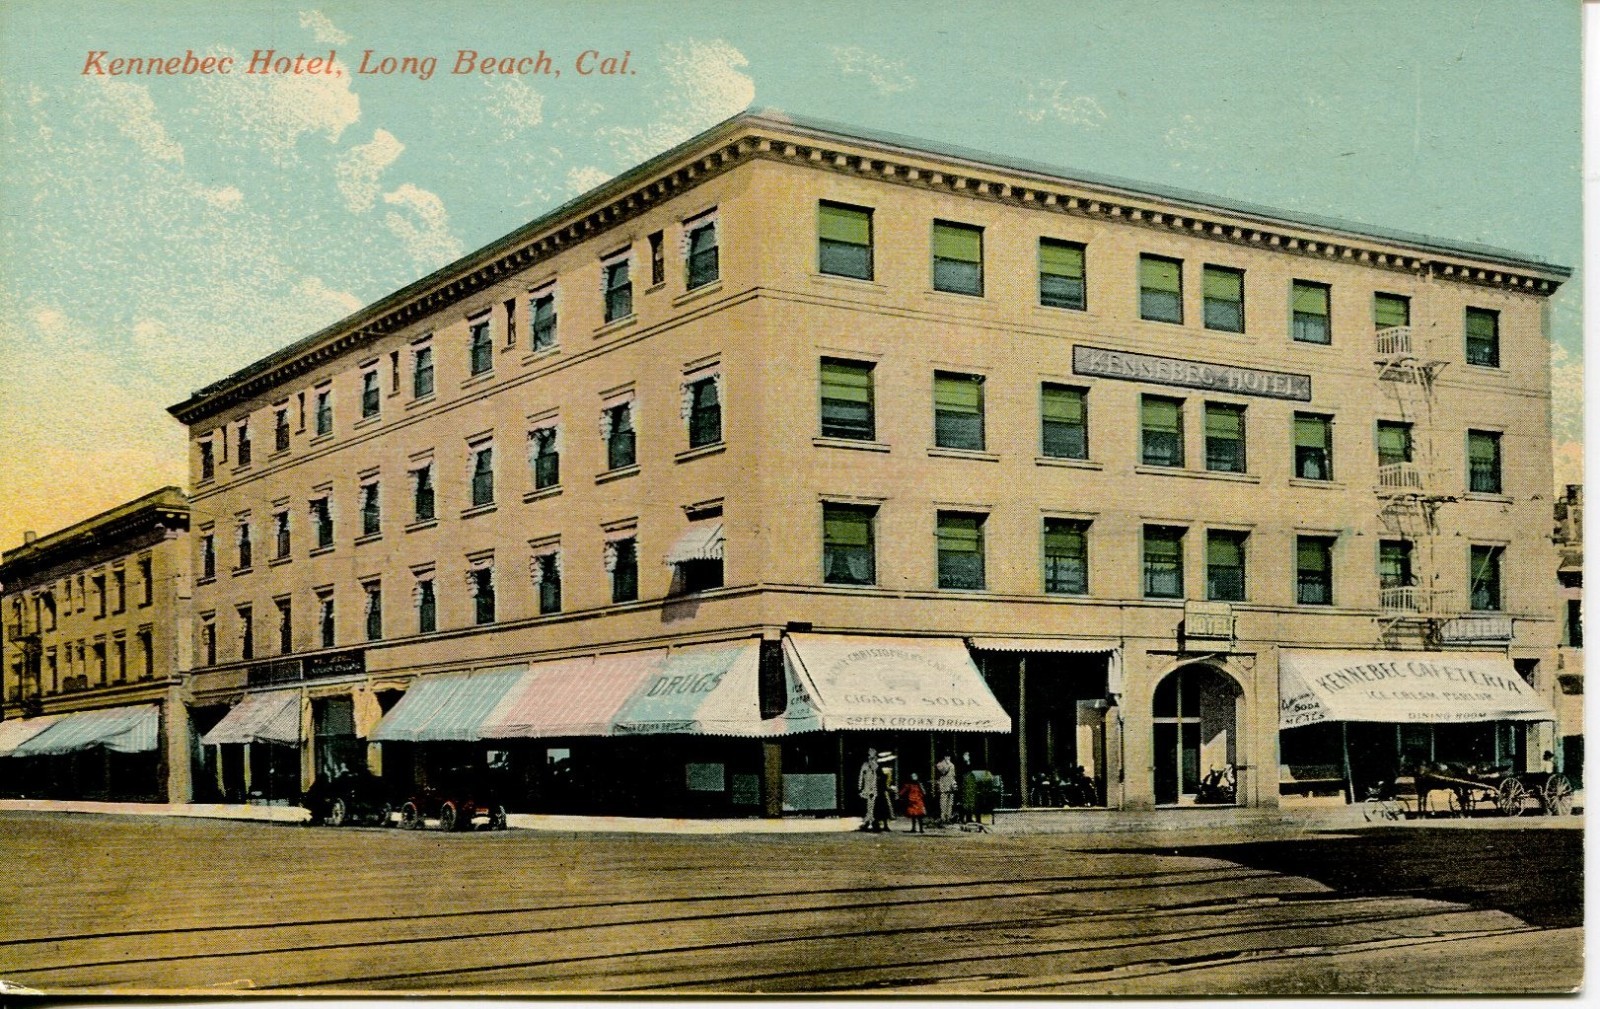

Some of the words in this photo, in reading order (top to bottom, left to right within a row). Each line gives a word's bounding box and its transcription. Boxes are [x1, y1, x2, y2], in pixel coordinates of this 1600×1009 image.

[1089, 353, 1216, 386] KENNEBEC
[1227, 370, 1297, 396] HOTEL
[1186, 614, 1231, 635] HOTEL
[647, 671, 729, 698] DRUGS
[1315, 661, 1407, 695] KENNEBEC
[1407, 661, 1523, 696] CAFETERIA
[844, 694, 907, 706] CIGARS
[922, 696, 981, 707] SODA
[1295, 702, 1320, 713] SODA
[889, 717, 935, 728] CROWN
